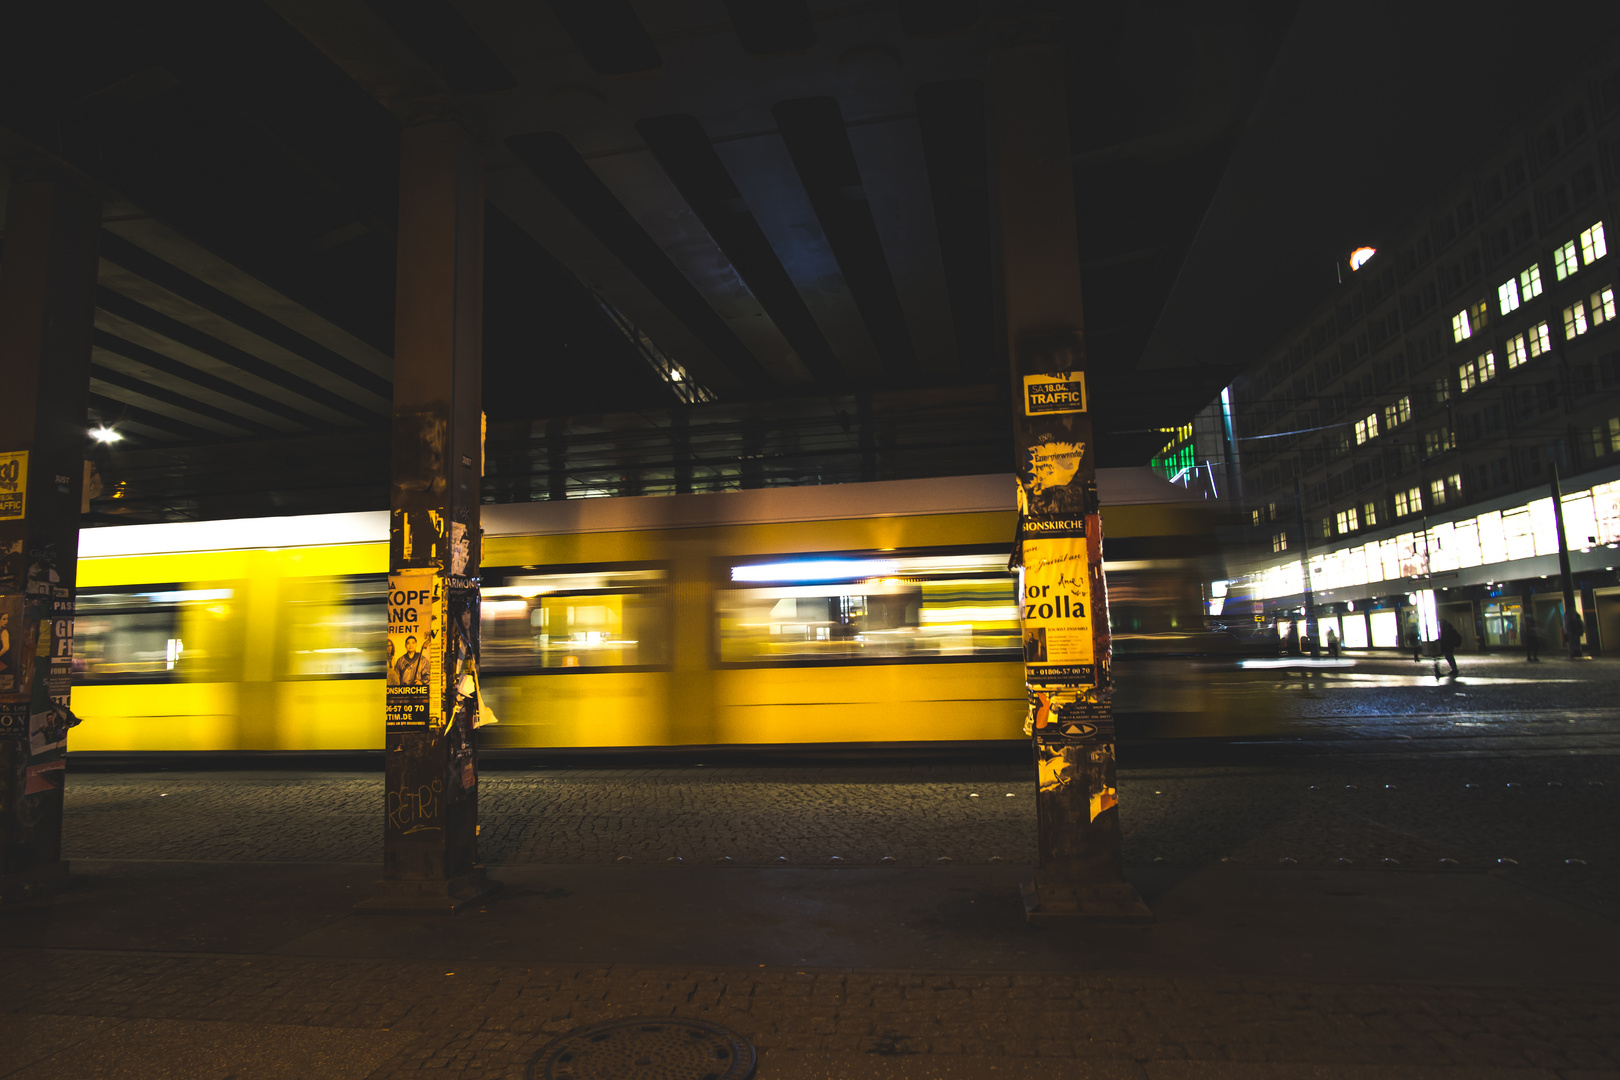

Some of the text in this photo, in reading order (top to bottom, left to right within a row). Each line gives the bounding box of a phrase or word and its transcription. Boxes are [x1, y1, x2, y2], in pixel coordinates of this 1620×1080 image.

[1030, 392, 1080, 404] TRAFFIC
[55, 475, 71, 484] JUST
[51, 667, 67, 675] FOUR
[415, 704, 425, 712] 70
